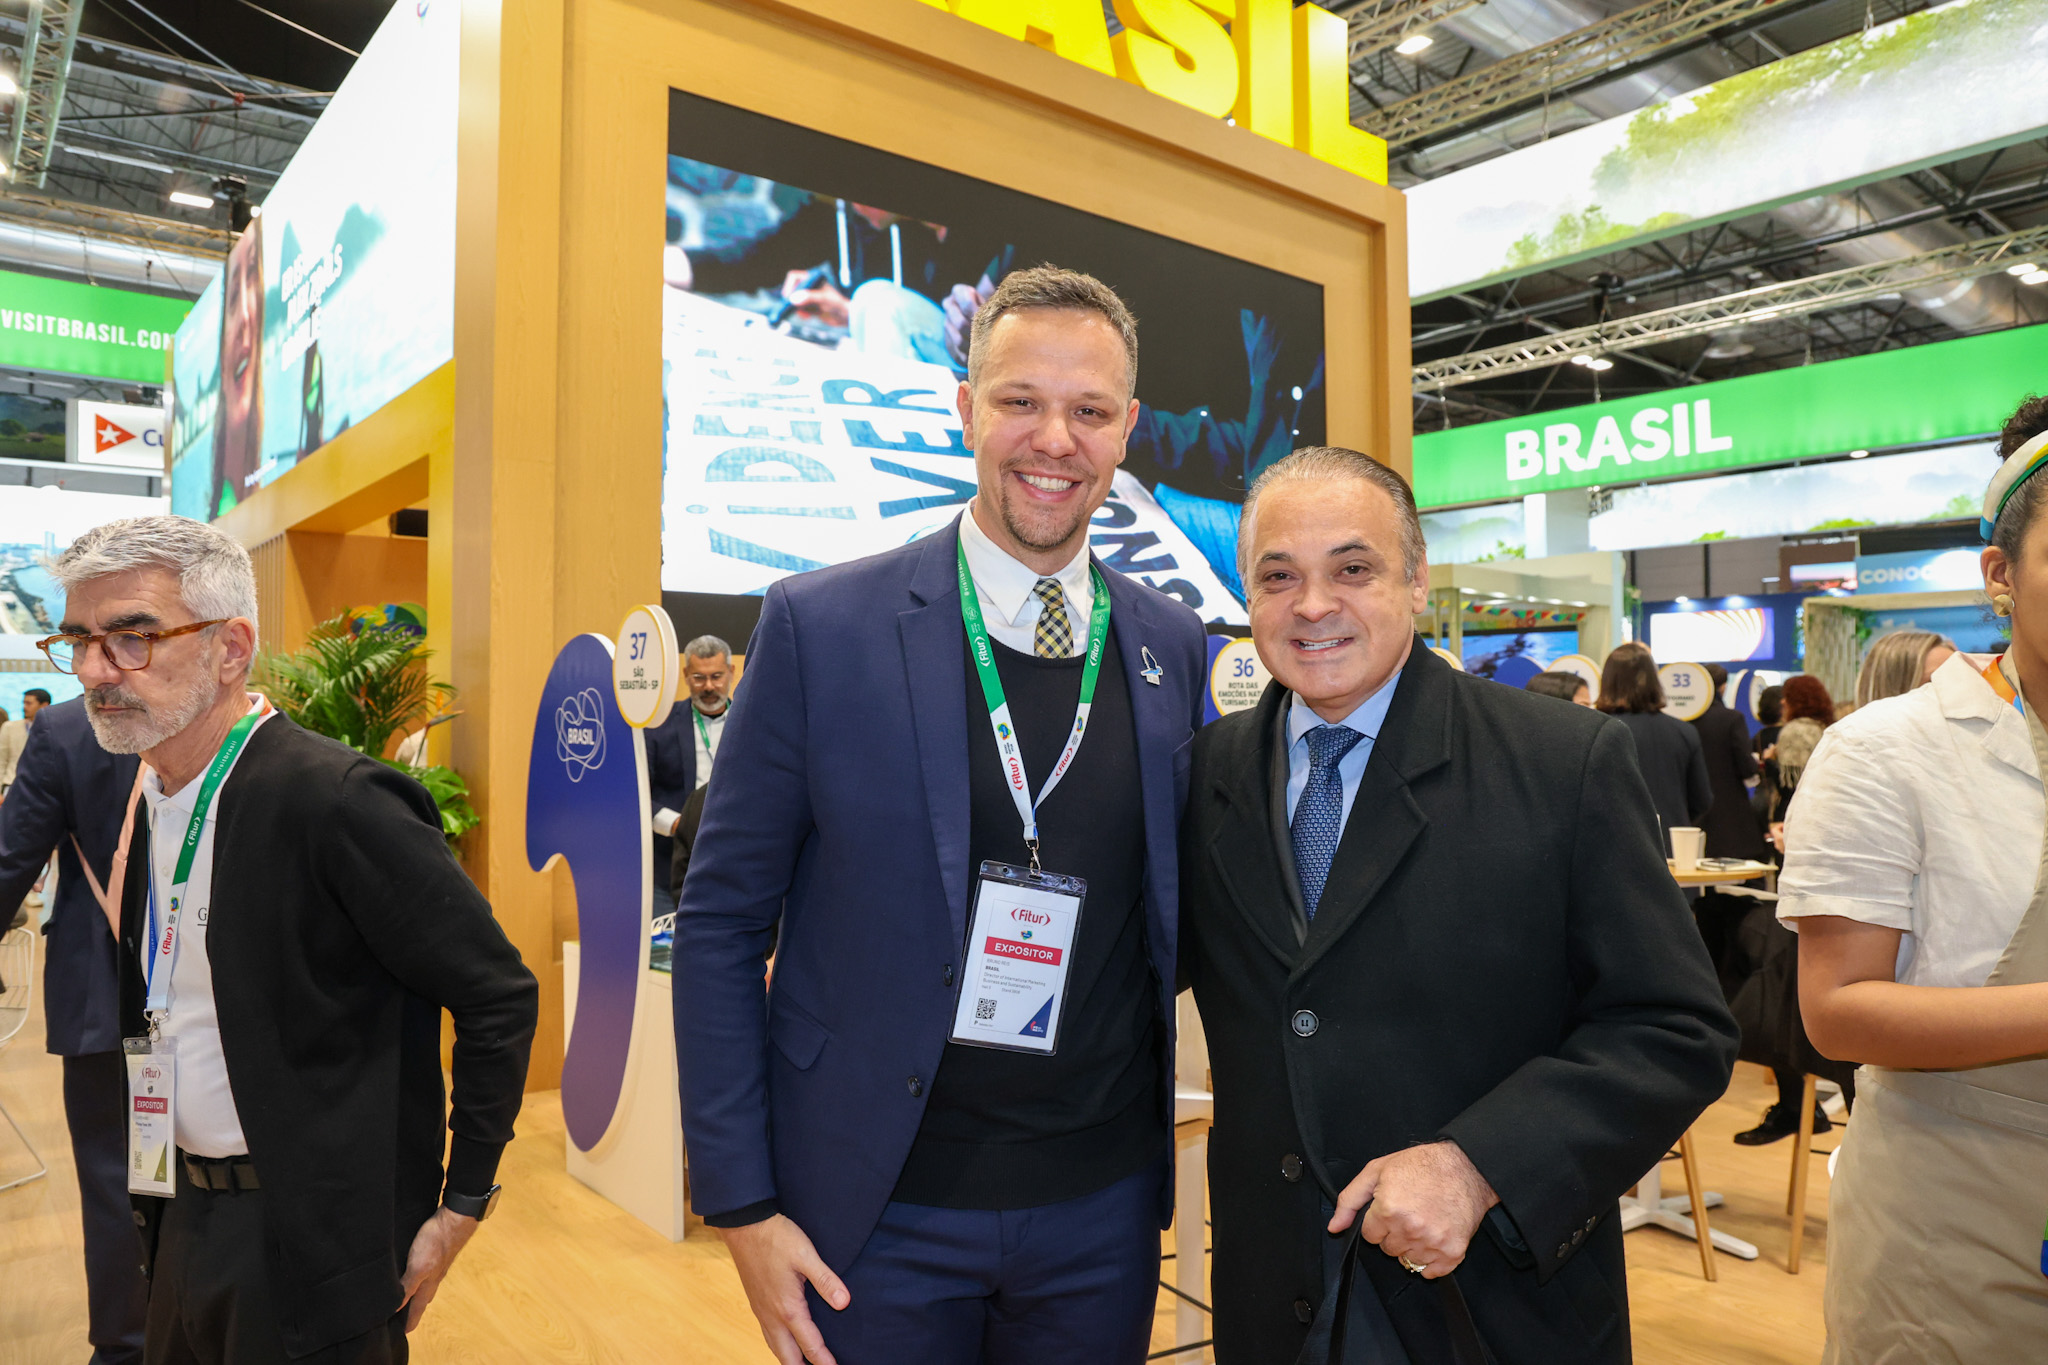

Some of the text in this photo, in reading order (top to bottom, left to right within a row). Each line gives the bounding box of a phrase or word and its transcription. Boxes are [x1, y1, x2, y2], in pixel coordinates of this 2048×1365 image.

[917, 0, 1388, 186] SIL
[1505, 398, 1733, 481] BRASIL
[630, 632, 647, 660] 37
[633, 666, 644, 678] SÃO
[1233, 657, 1254, 677] 36
[619, 680, 647, 690] SEBASTIÃO
[651, 680, 659, 690] SP
[1672, 673, 1690, 688] 33
[1218, 689, 1262, 698] EMOÇÕES NAT
[567, 728, 595, 746] BRASIL
[212, 740, 237, 778] @visitbrasil
[994, 942, 1054, 960] EXPOSITOR
[136, 1100, 164, 1110] EXPOSITOR
